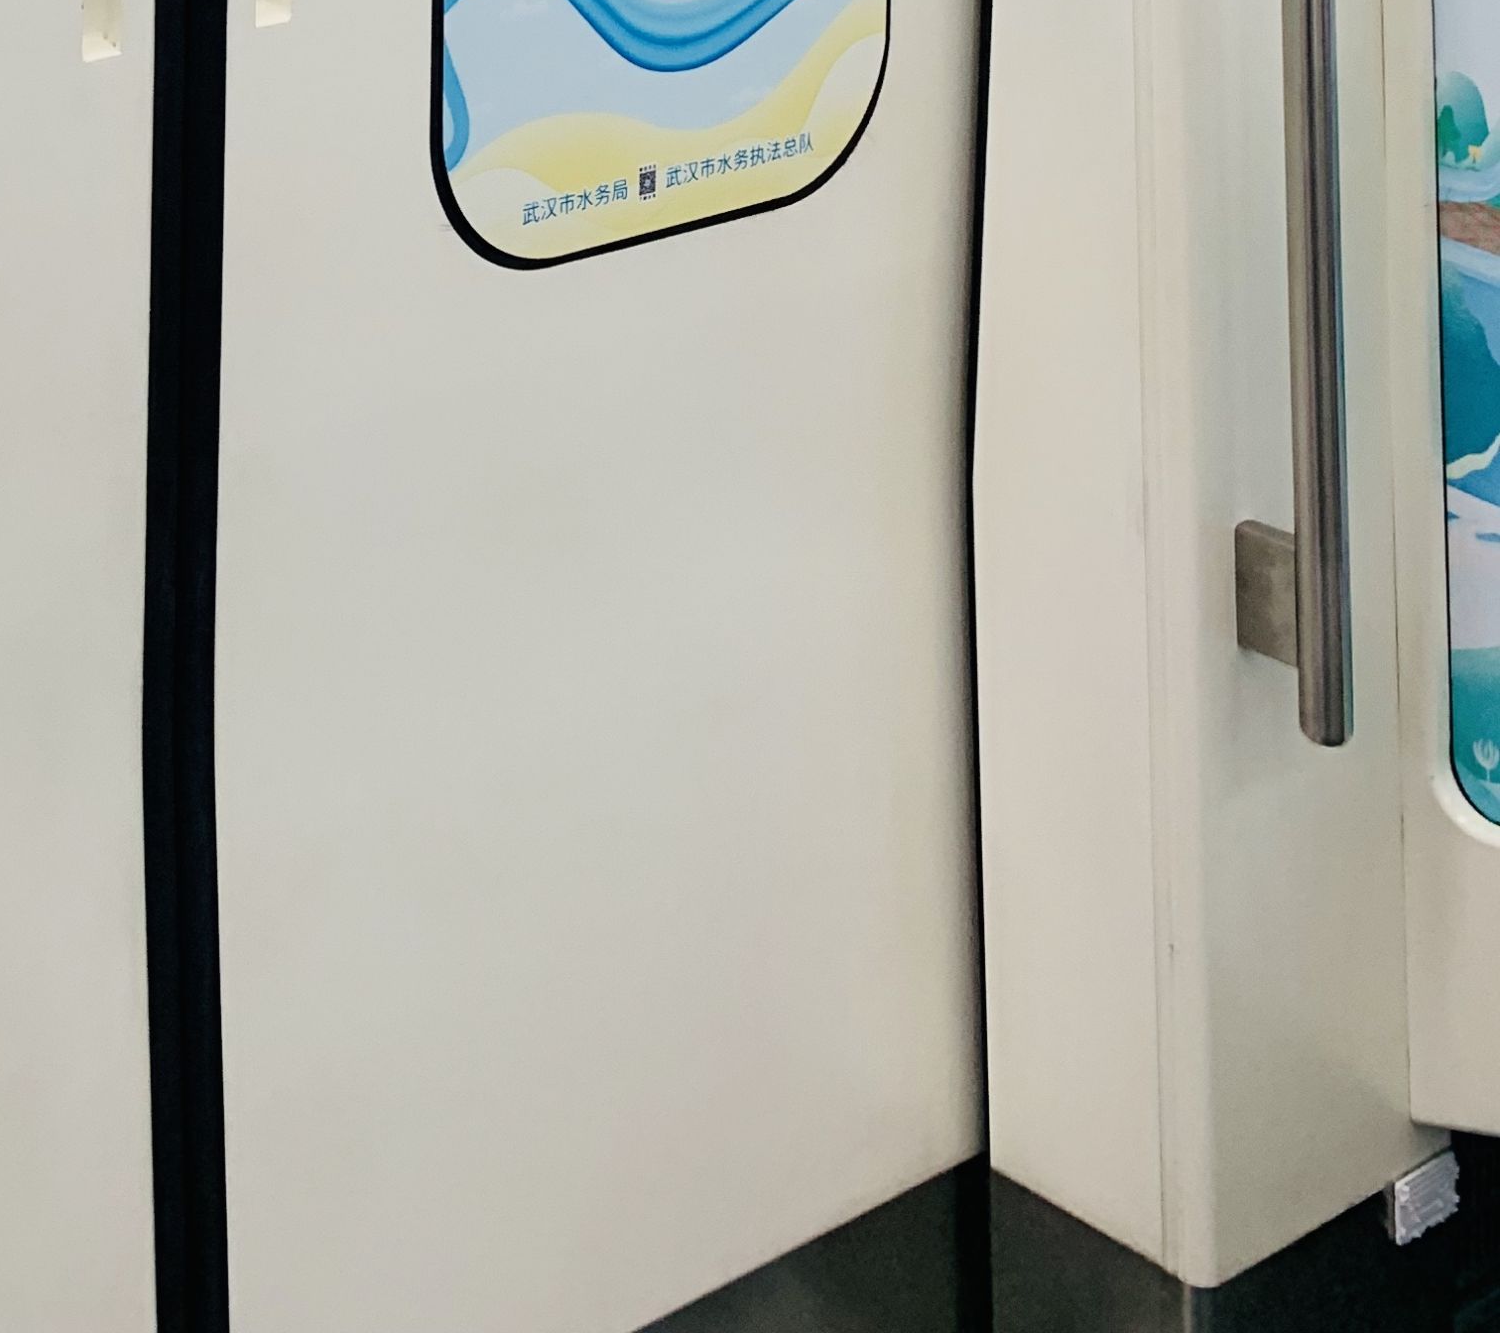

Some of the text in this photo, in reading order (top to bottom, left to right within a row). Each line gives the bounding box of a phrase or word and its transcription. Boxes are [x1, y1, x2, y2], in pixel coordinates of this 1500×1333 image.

[664, 133, 814, 189] 武汉市水务执法总队
[522, 178, 628, 227] 武汉市水务局
